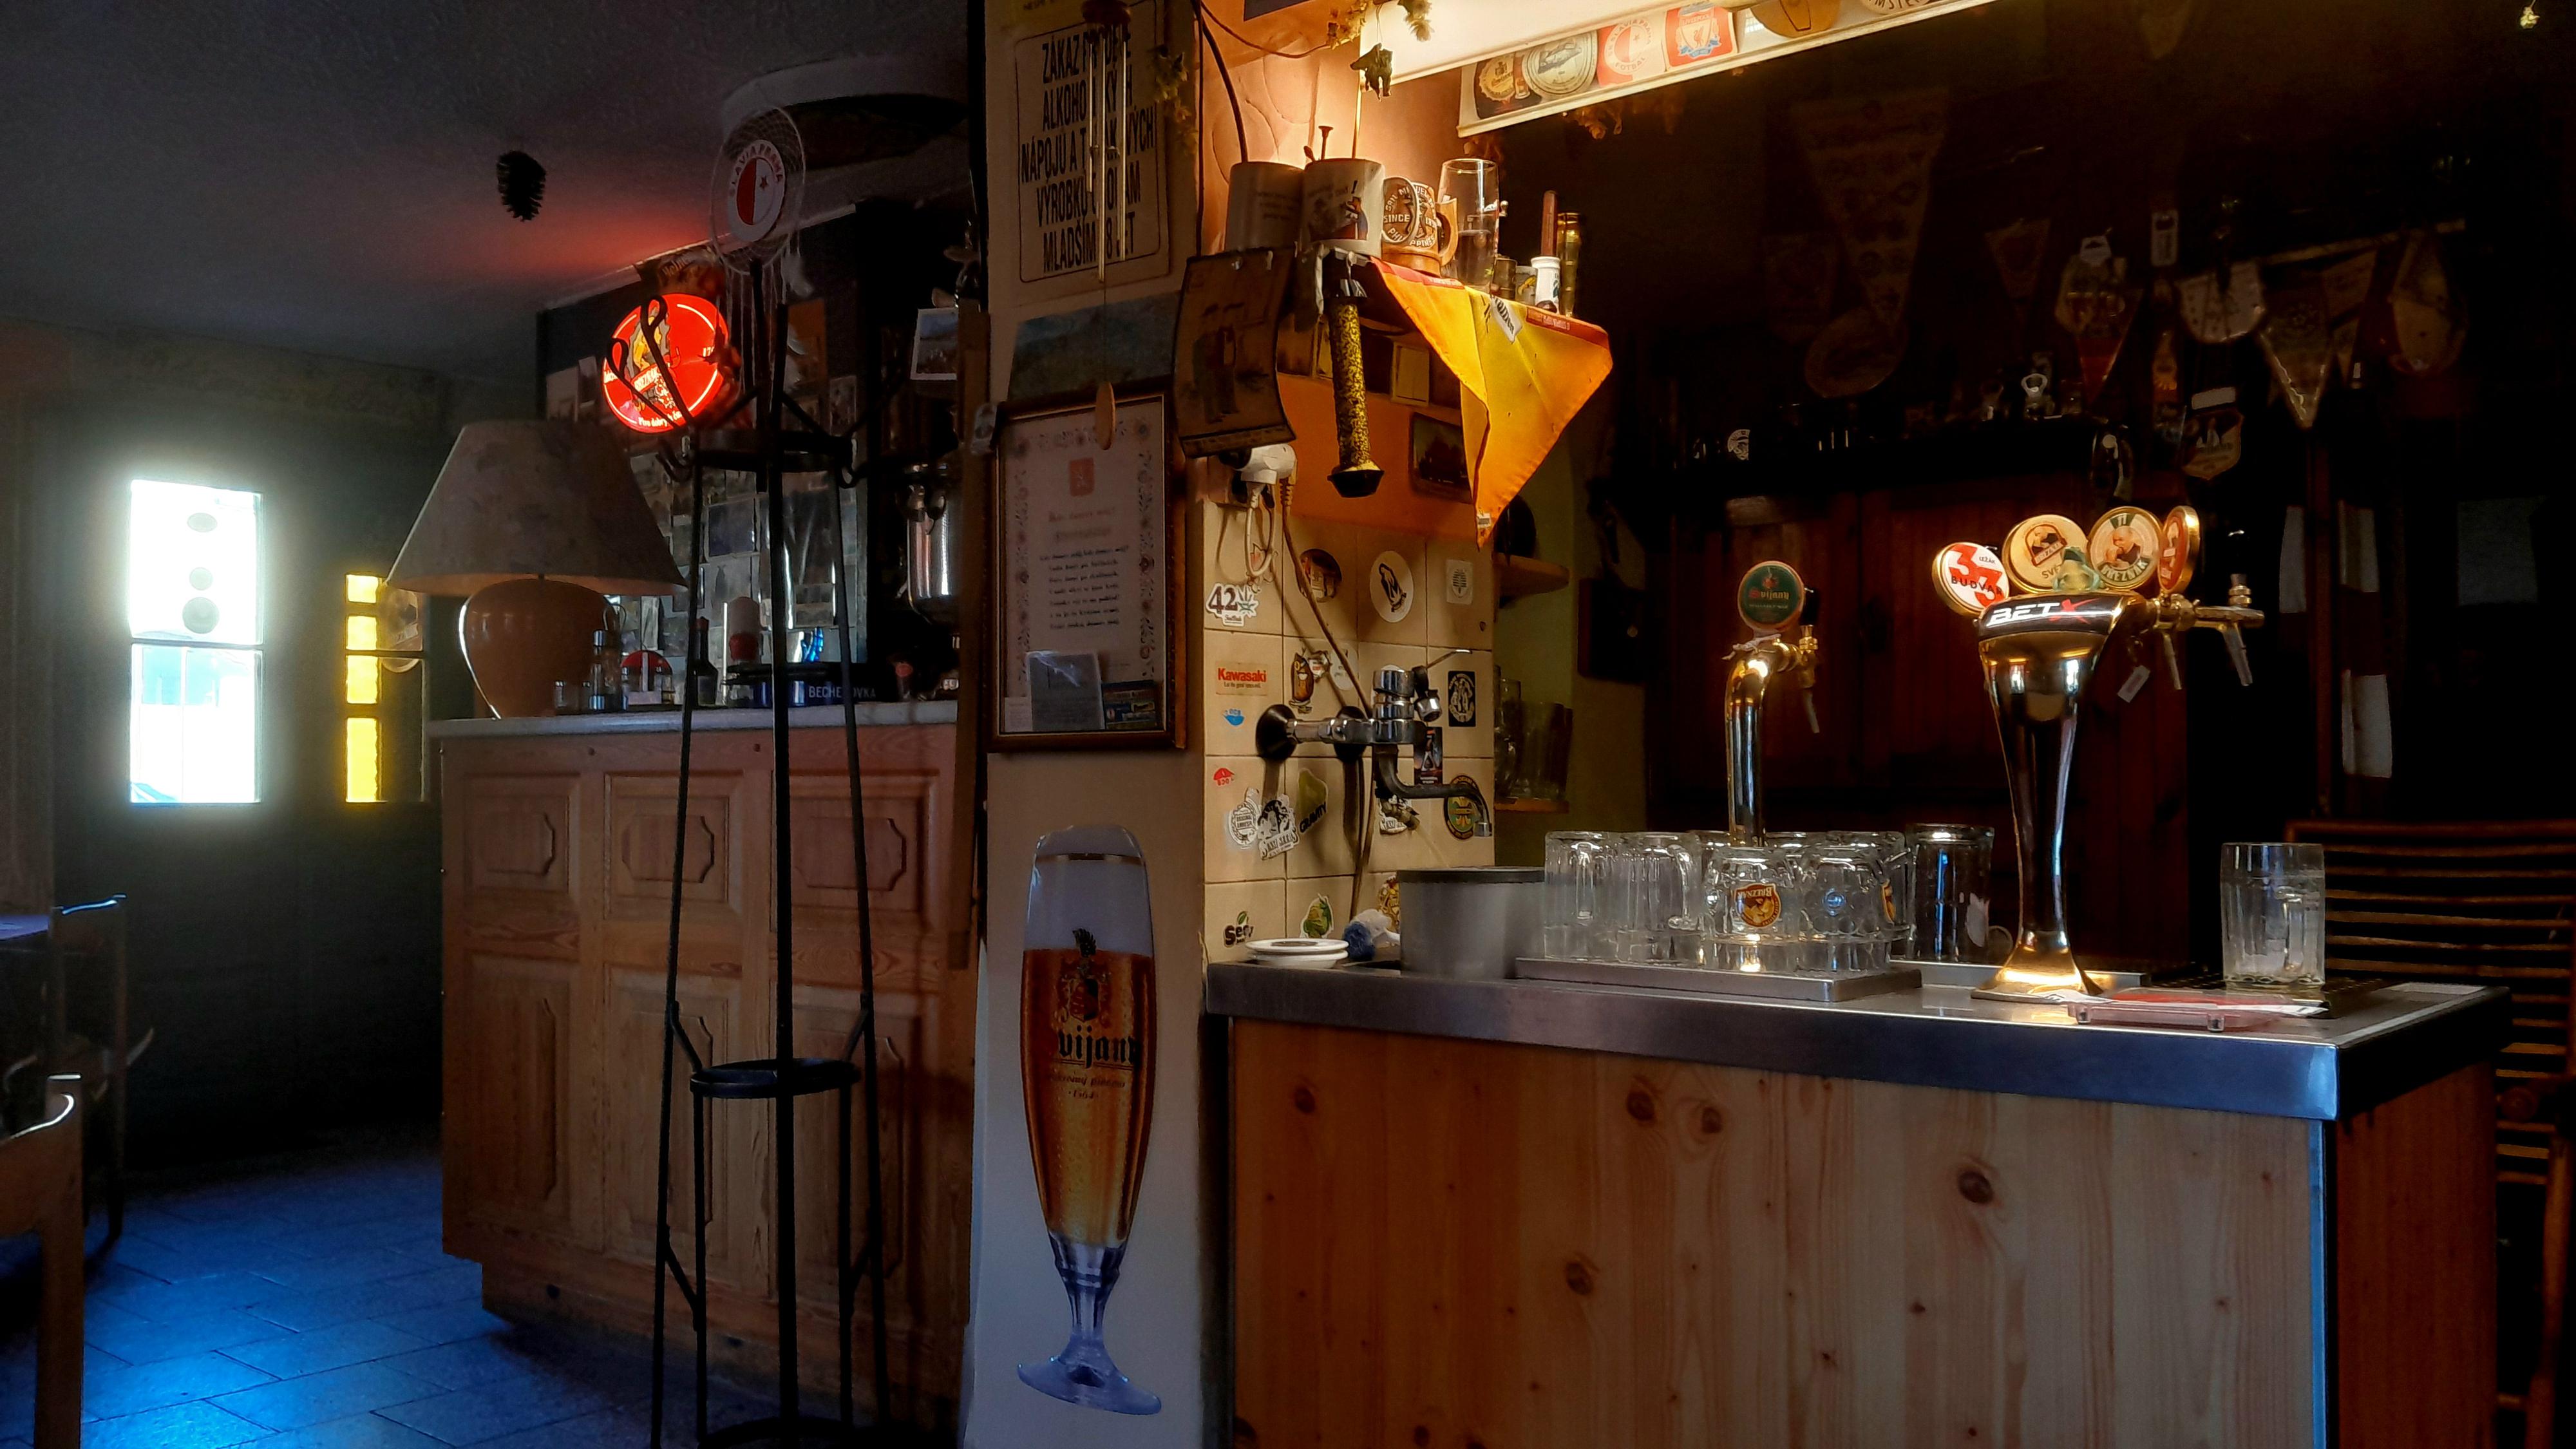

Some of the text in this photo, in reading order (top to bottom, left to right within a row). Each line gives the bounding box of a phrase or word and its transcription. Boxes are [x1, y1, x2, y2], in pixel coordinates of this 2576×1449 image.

[1042, 35, 1079, 84] ZÁKAZ
[1069, 131, 1078, 171] A
[1383, 213, 1410, 223] SINCE
[1387, 227, 1435, 247] PHIPPINES
[1951, 575, 2003, 596] BUDVAR
[1218, 668, 1267, 683] Kawasaki
[1299, 802, 1327, 833] GRAVITY
